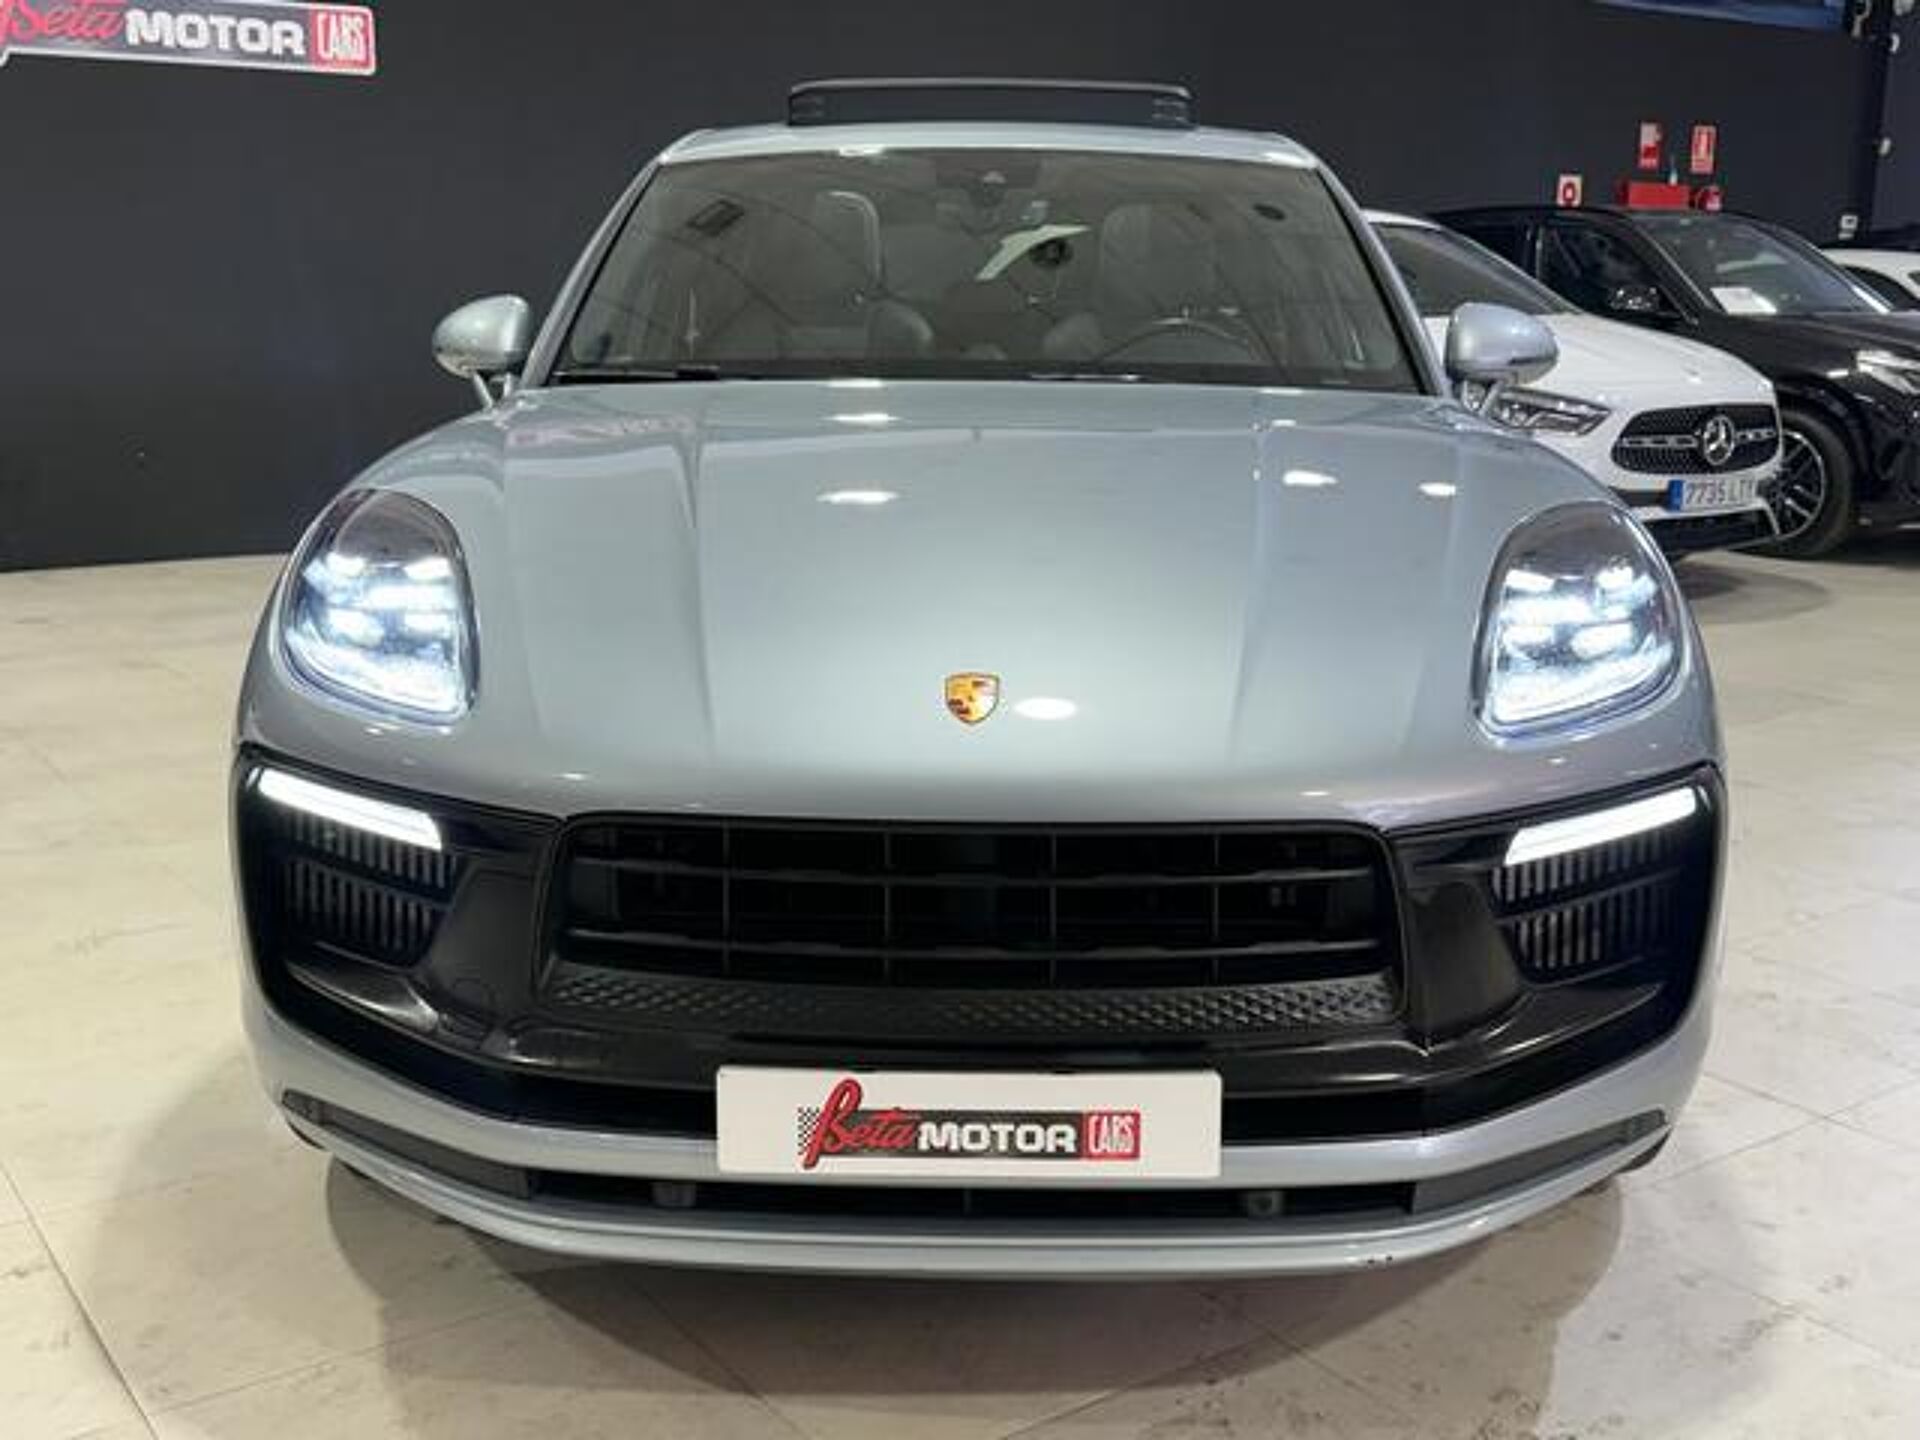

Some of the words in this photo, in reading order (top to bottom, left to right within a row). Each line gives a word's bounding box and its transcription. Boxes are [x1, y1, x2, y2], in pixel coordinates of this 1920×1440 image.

[125, 9, 306, 55] MOTOR
[317, 12, 366, 62] CARS
[803, 1079, 918, 1169] Beta
[917, 1121, 1077, 1153] MOTOR
[1088, 1114, 1136, 1154] CARS
